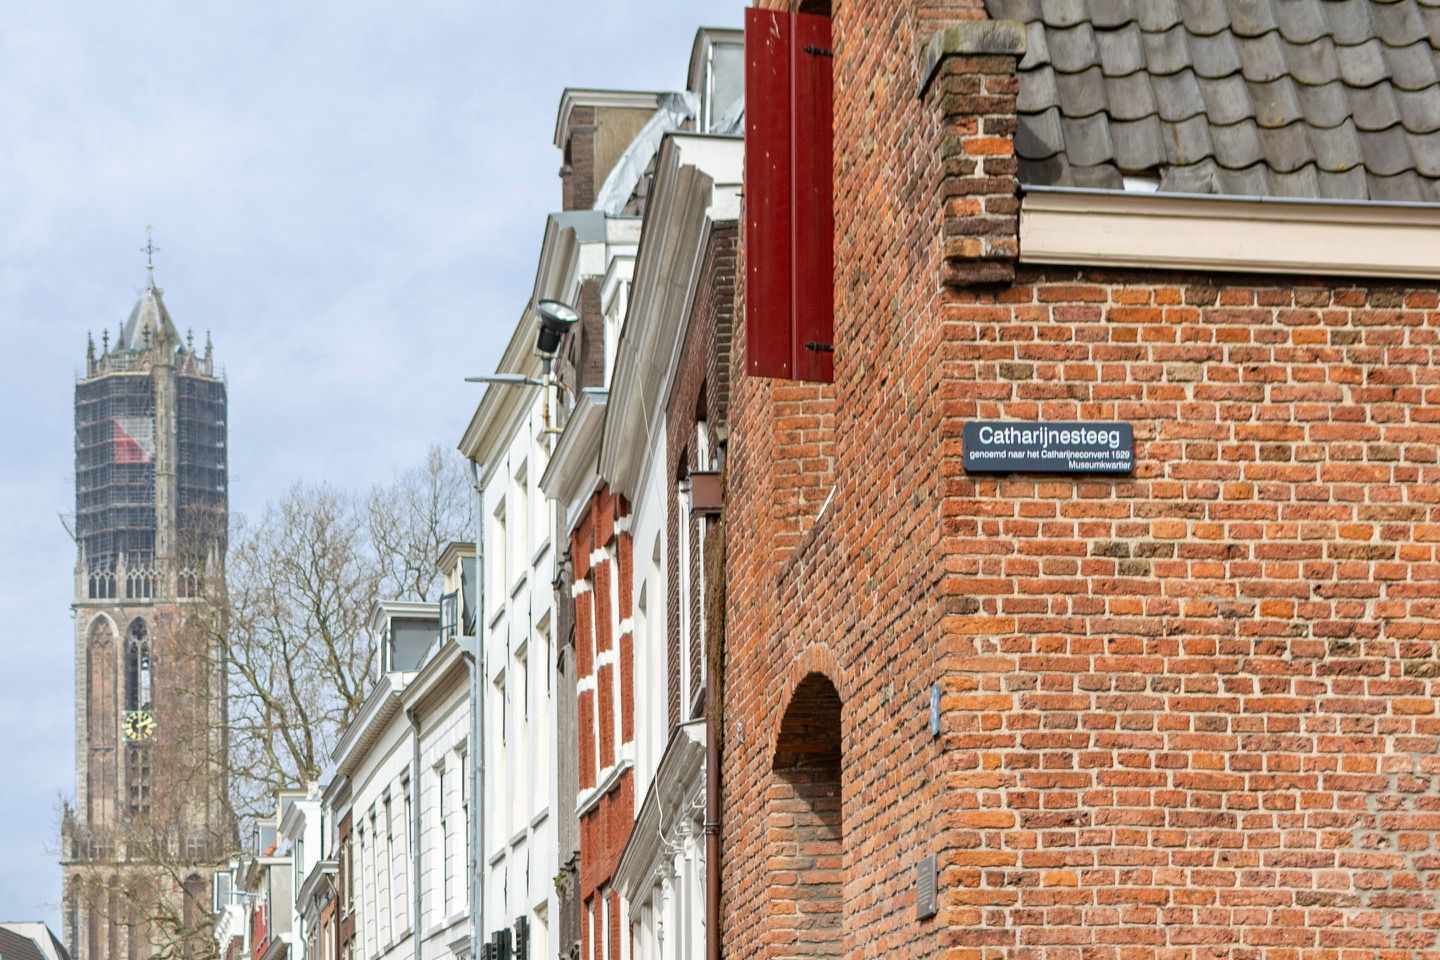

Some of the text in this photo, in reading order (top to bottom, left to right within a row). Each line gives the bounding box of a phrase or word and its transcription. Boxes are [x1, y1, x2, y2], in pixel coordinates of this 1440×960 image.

[979, 426, 1120, 449] Catharijnesteeg
[970, 450, 1006, 460] genoemd
[1009, 450, 1025, 459] naar
[1027, 450, 1039, 459] het
[1041, 450, 1109, 460] Catharijneconvent
[1069, 460, 1131, 470] Museumkwartier
